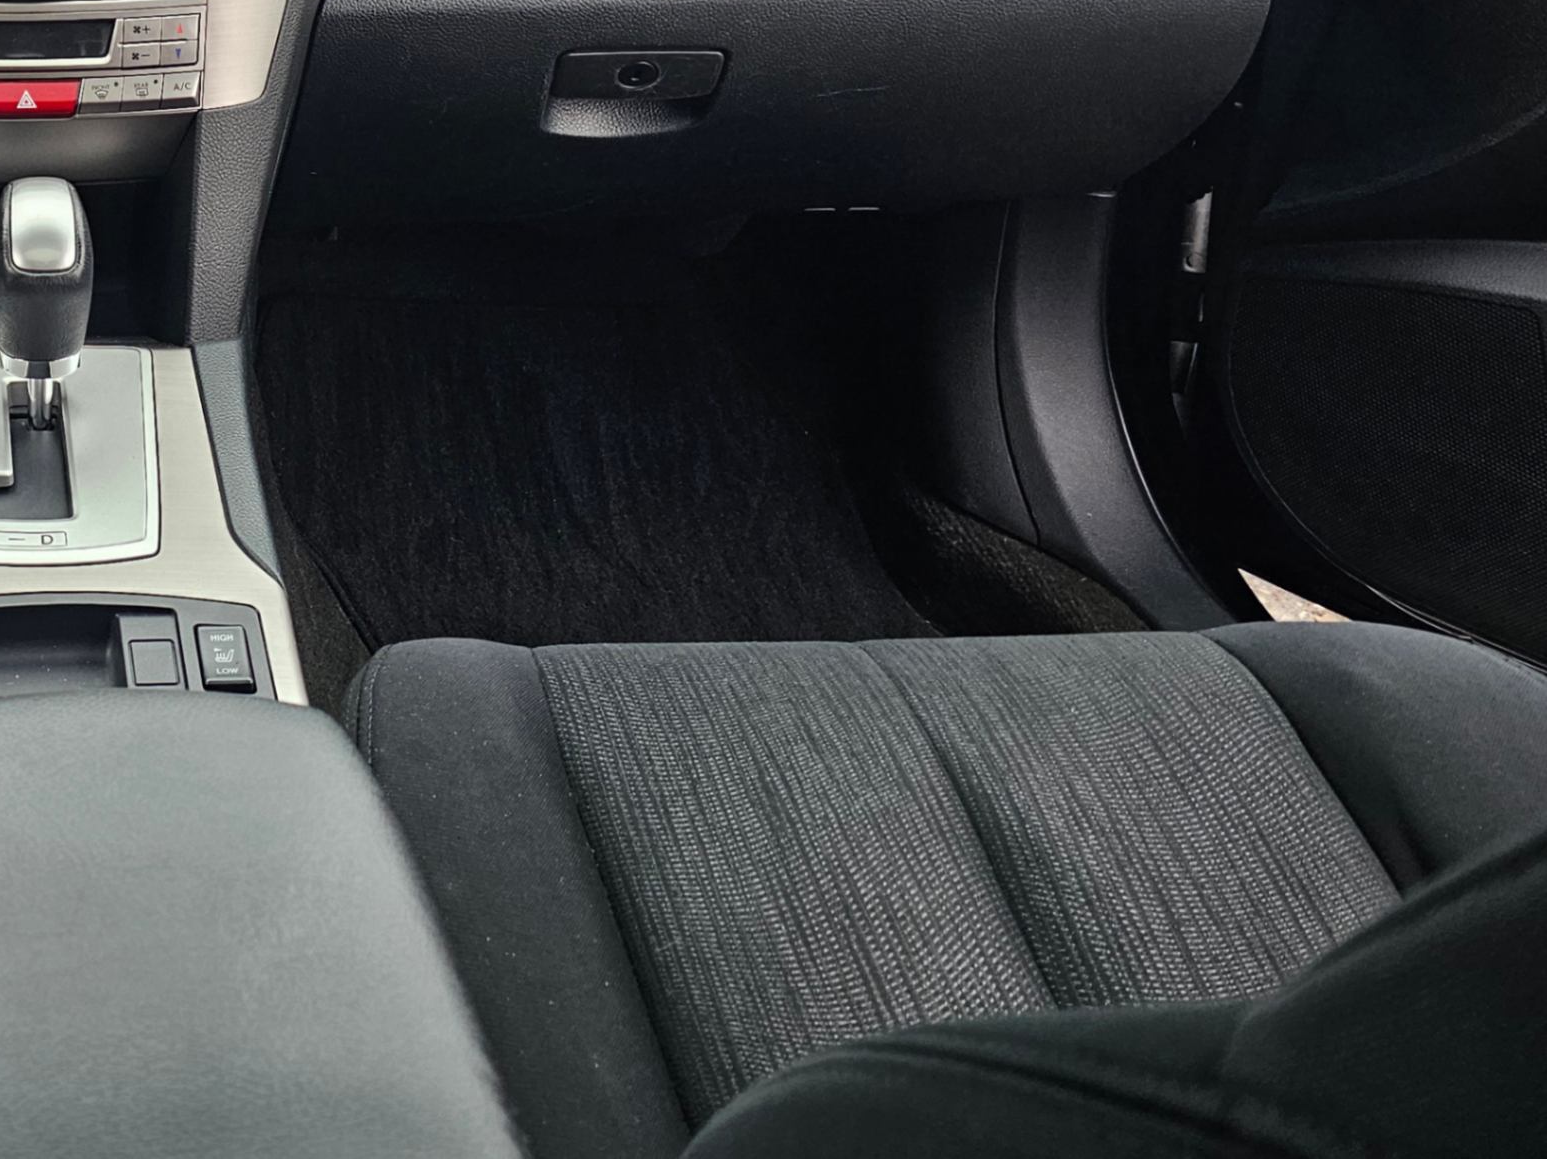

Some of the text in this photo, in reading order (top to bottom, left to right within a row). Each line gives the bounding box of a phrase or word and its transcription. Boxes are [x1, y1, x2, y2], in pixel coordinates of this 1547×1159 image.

[173, 81, 192, 92] A/C
[40, 534, 54, 545] D
[209, 633, 235, 642] HIGH
[215, 666, 240, 675] LOW
